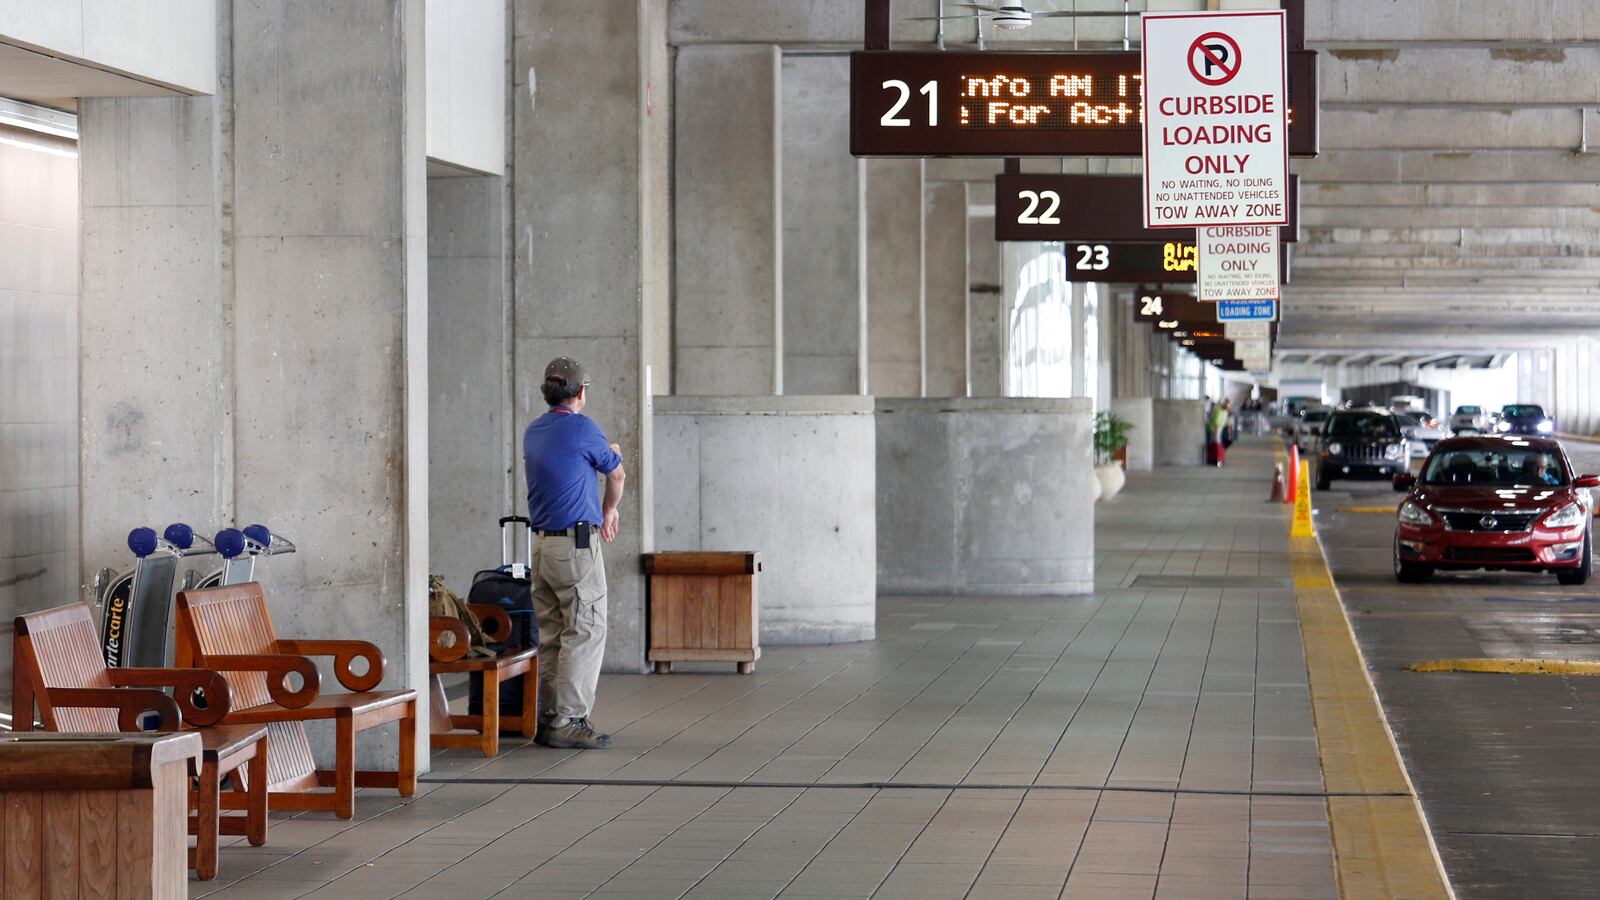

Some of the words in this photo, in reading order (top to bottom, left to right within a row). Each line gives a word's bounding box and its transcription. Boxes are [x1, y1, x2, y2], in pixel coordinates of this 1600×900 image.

[961, 75, 1030, 97] nfo
[1050, 75, 1092, 97] AM
[880, 79, 938, 127] 21
[988, 102, 1050, 124] For
[1159, 94, 1274, 116] CURBSIDE
[1163, 124, 1272, 146] LOADING
[1185, 154, 1250, 175] ONLY
[1161, 180, 1176, 189] NO
[1180, 179, 1223, 189] WAITING,
[1226, 178, 1240, 188] NO
[1244, 178, 1273, 187] IDLING
[1156, 192, 1170, 201] NO
[1173, 191, 1234, 201] UNATTENDED
[1238, 190, 1279, 200] VEHICLES
[1017, 190, 1061, 224] 22
[1155, 206, 1188, 219] TOW
[1195, 204, 1239, 218] AWAY
[1246, 203, 1282, 217] ZONE
[1206, 226, 1272, 238] CURBSIDE
[1075, 244, 1110, 270] 23
[1208, 242, 1271, 254] LOADING
[1221, 260, 1258, 271] ONLY
[1204, 288, 1223, 297] TOW
[1227, 288, 1252, 296] AWAY
[1255, 287, 1276, 296] ZONE
[1140, 296, 1163, 316] 24
[1220, 306, 1250, 316] LOADING
[1253, 305, 1271, 316] ZONE
[106, 597, 124, 668] artecarte
